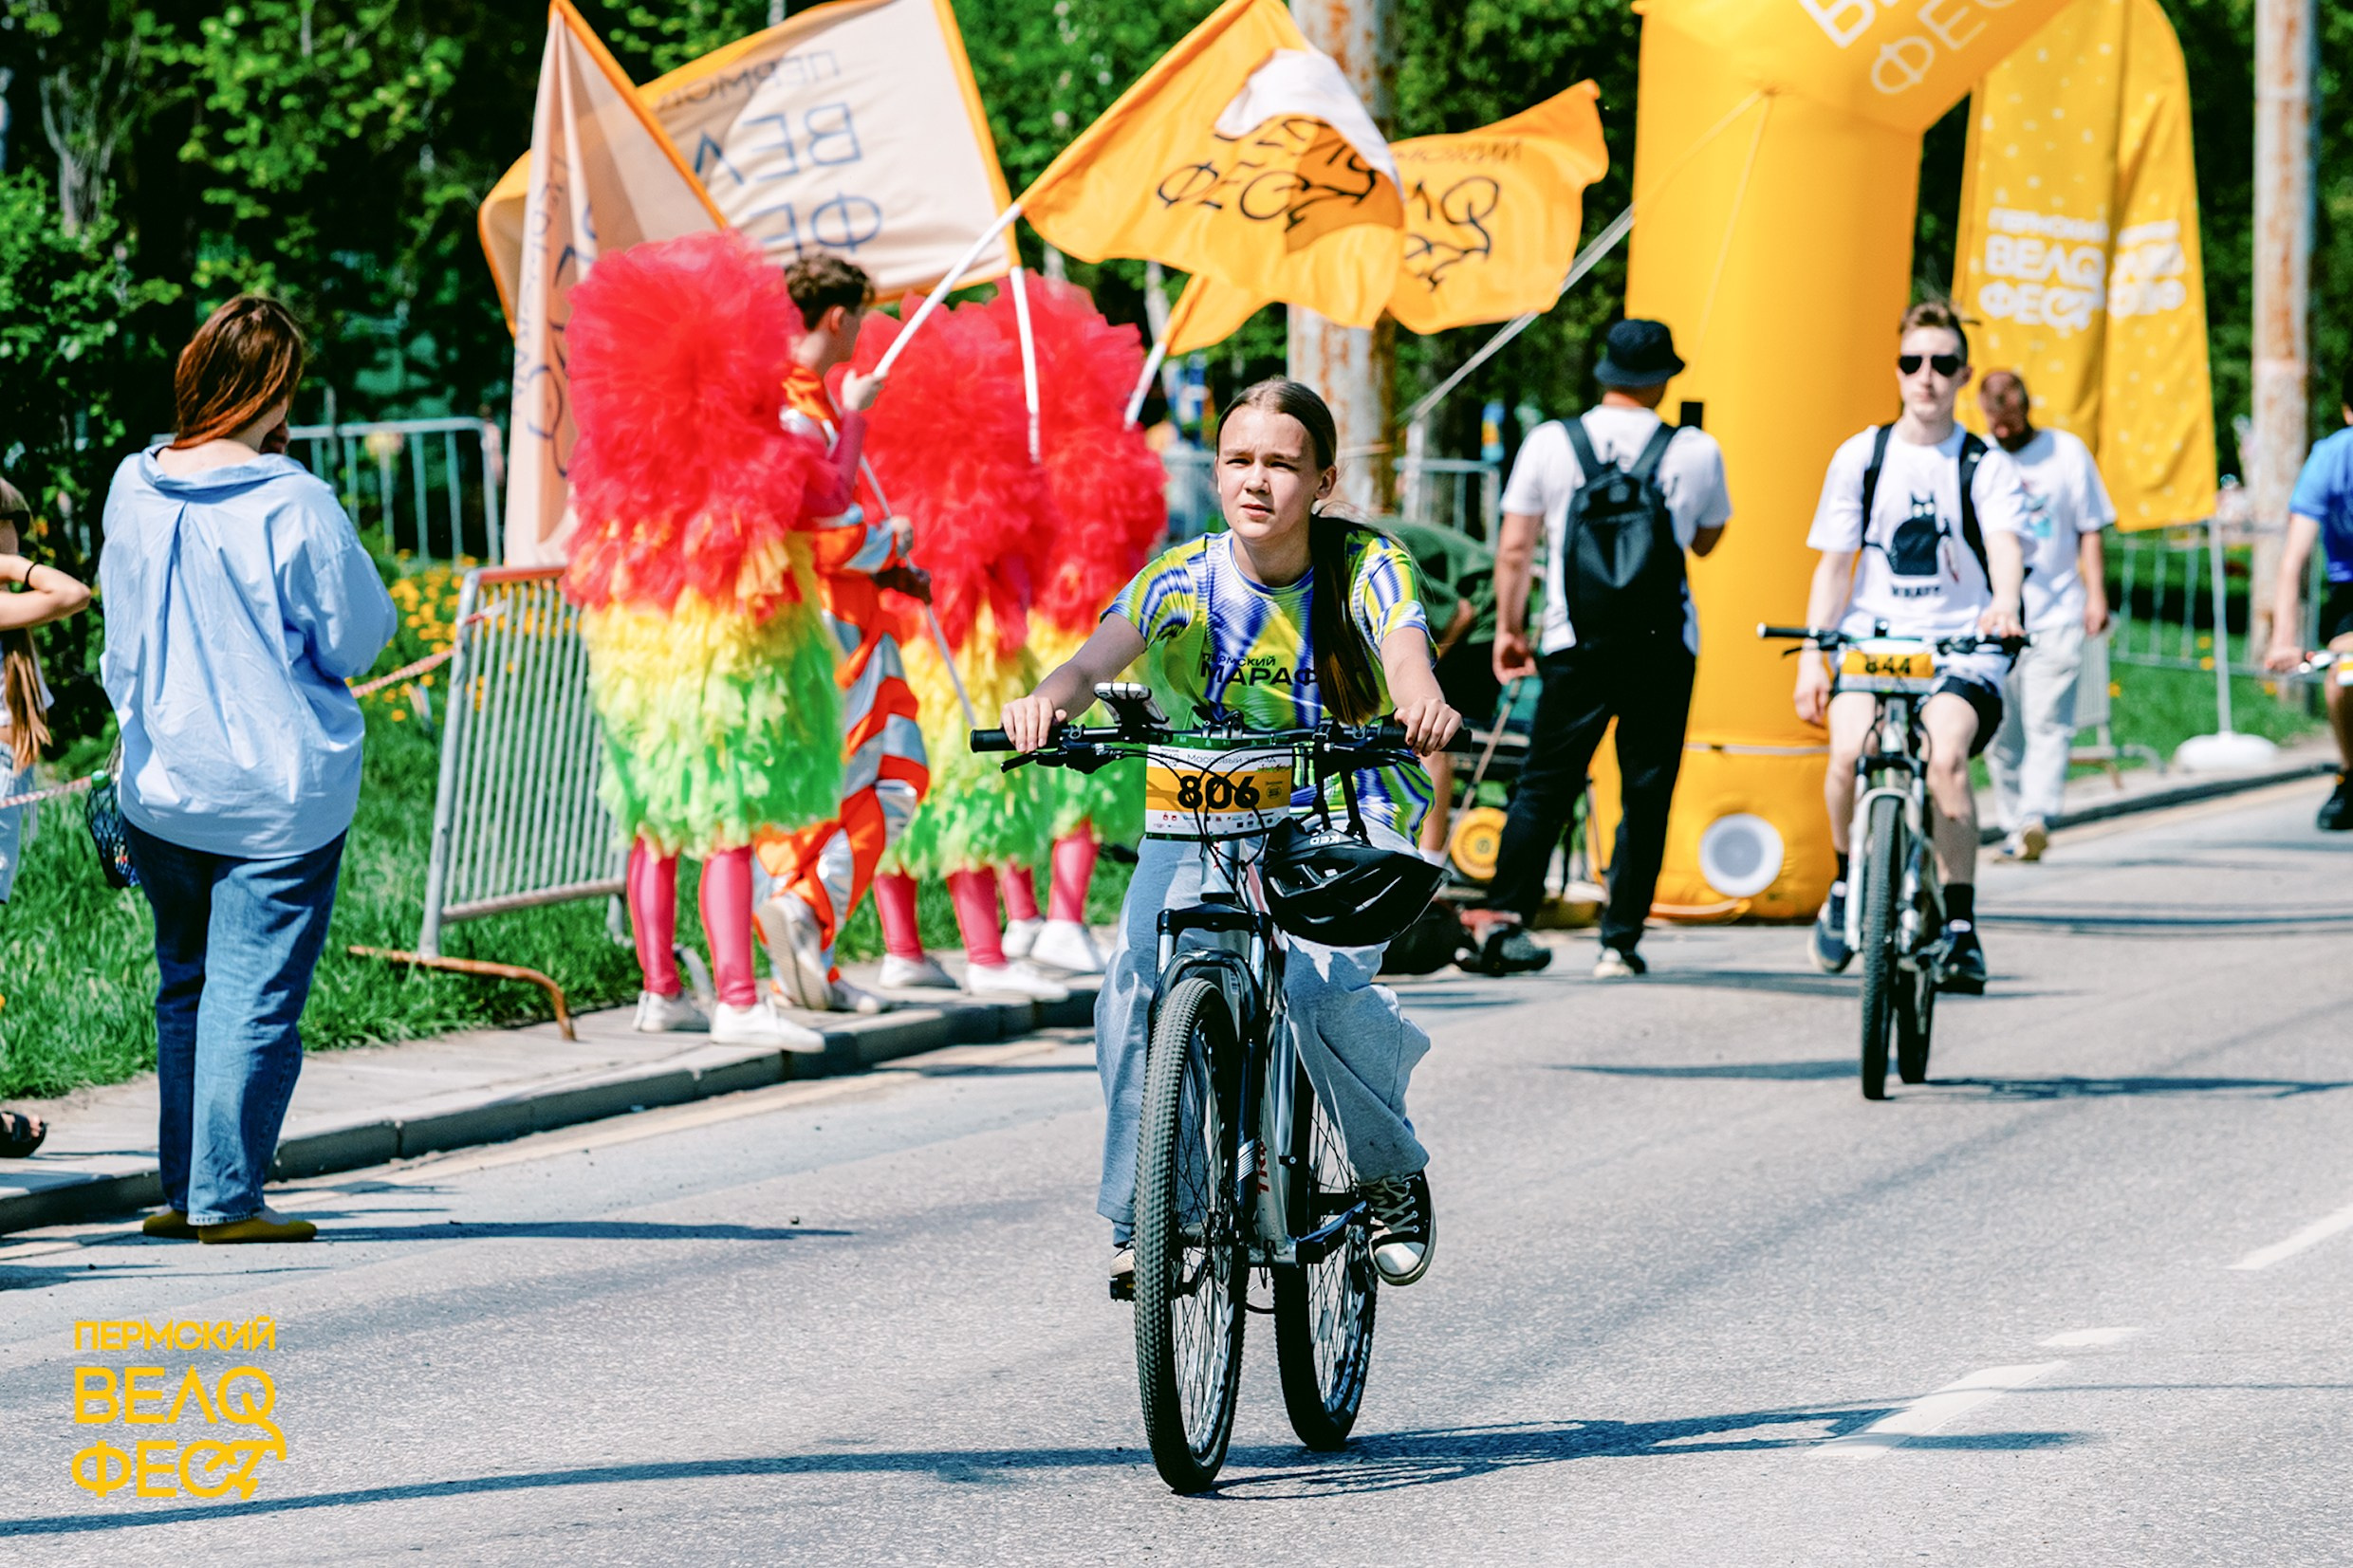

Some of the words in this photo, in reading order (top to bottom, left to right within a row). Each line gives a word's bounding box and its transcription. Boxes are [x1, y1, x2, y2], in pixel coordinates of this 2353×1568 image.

[1870, 0, 2017, 95] ФЕ
[1200, 661, 1318, 687] МАРАФ
[1865, 655, 1911, 674] 844
[1177, 775, 1260, 809] 806
